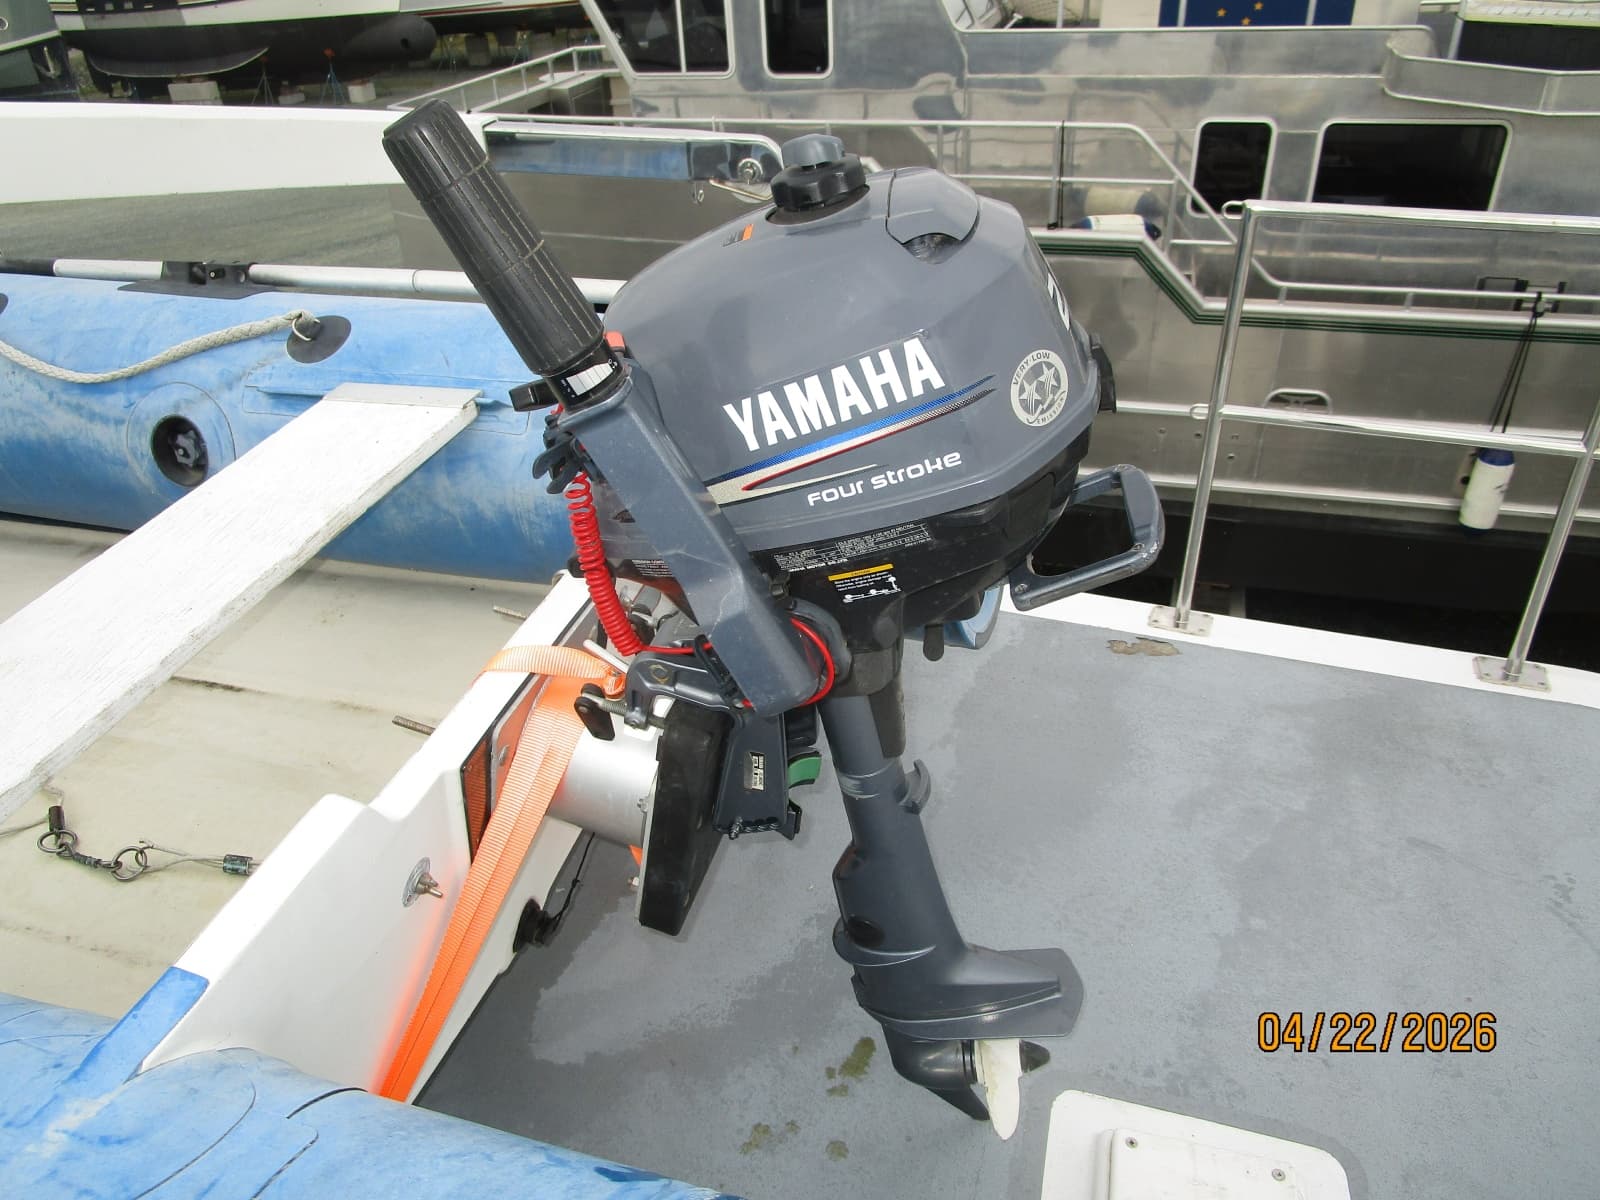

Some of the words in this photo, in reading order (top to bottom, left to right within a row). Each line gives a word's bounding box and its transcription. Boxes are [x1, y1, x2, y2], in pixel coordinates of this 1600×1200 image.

[723, 338, 945, 451] YAMAHA
[1012, 359, 1030, 385] VERY
[1031, 351, 1050, 361] LOW
